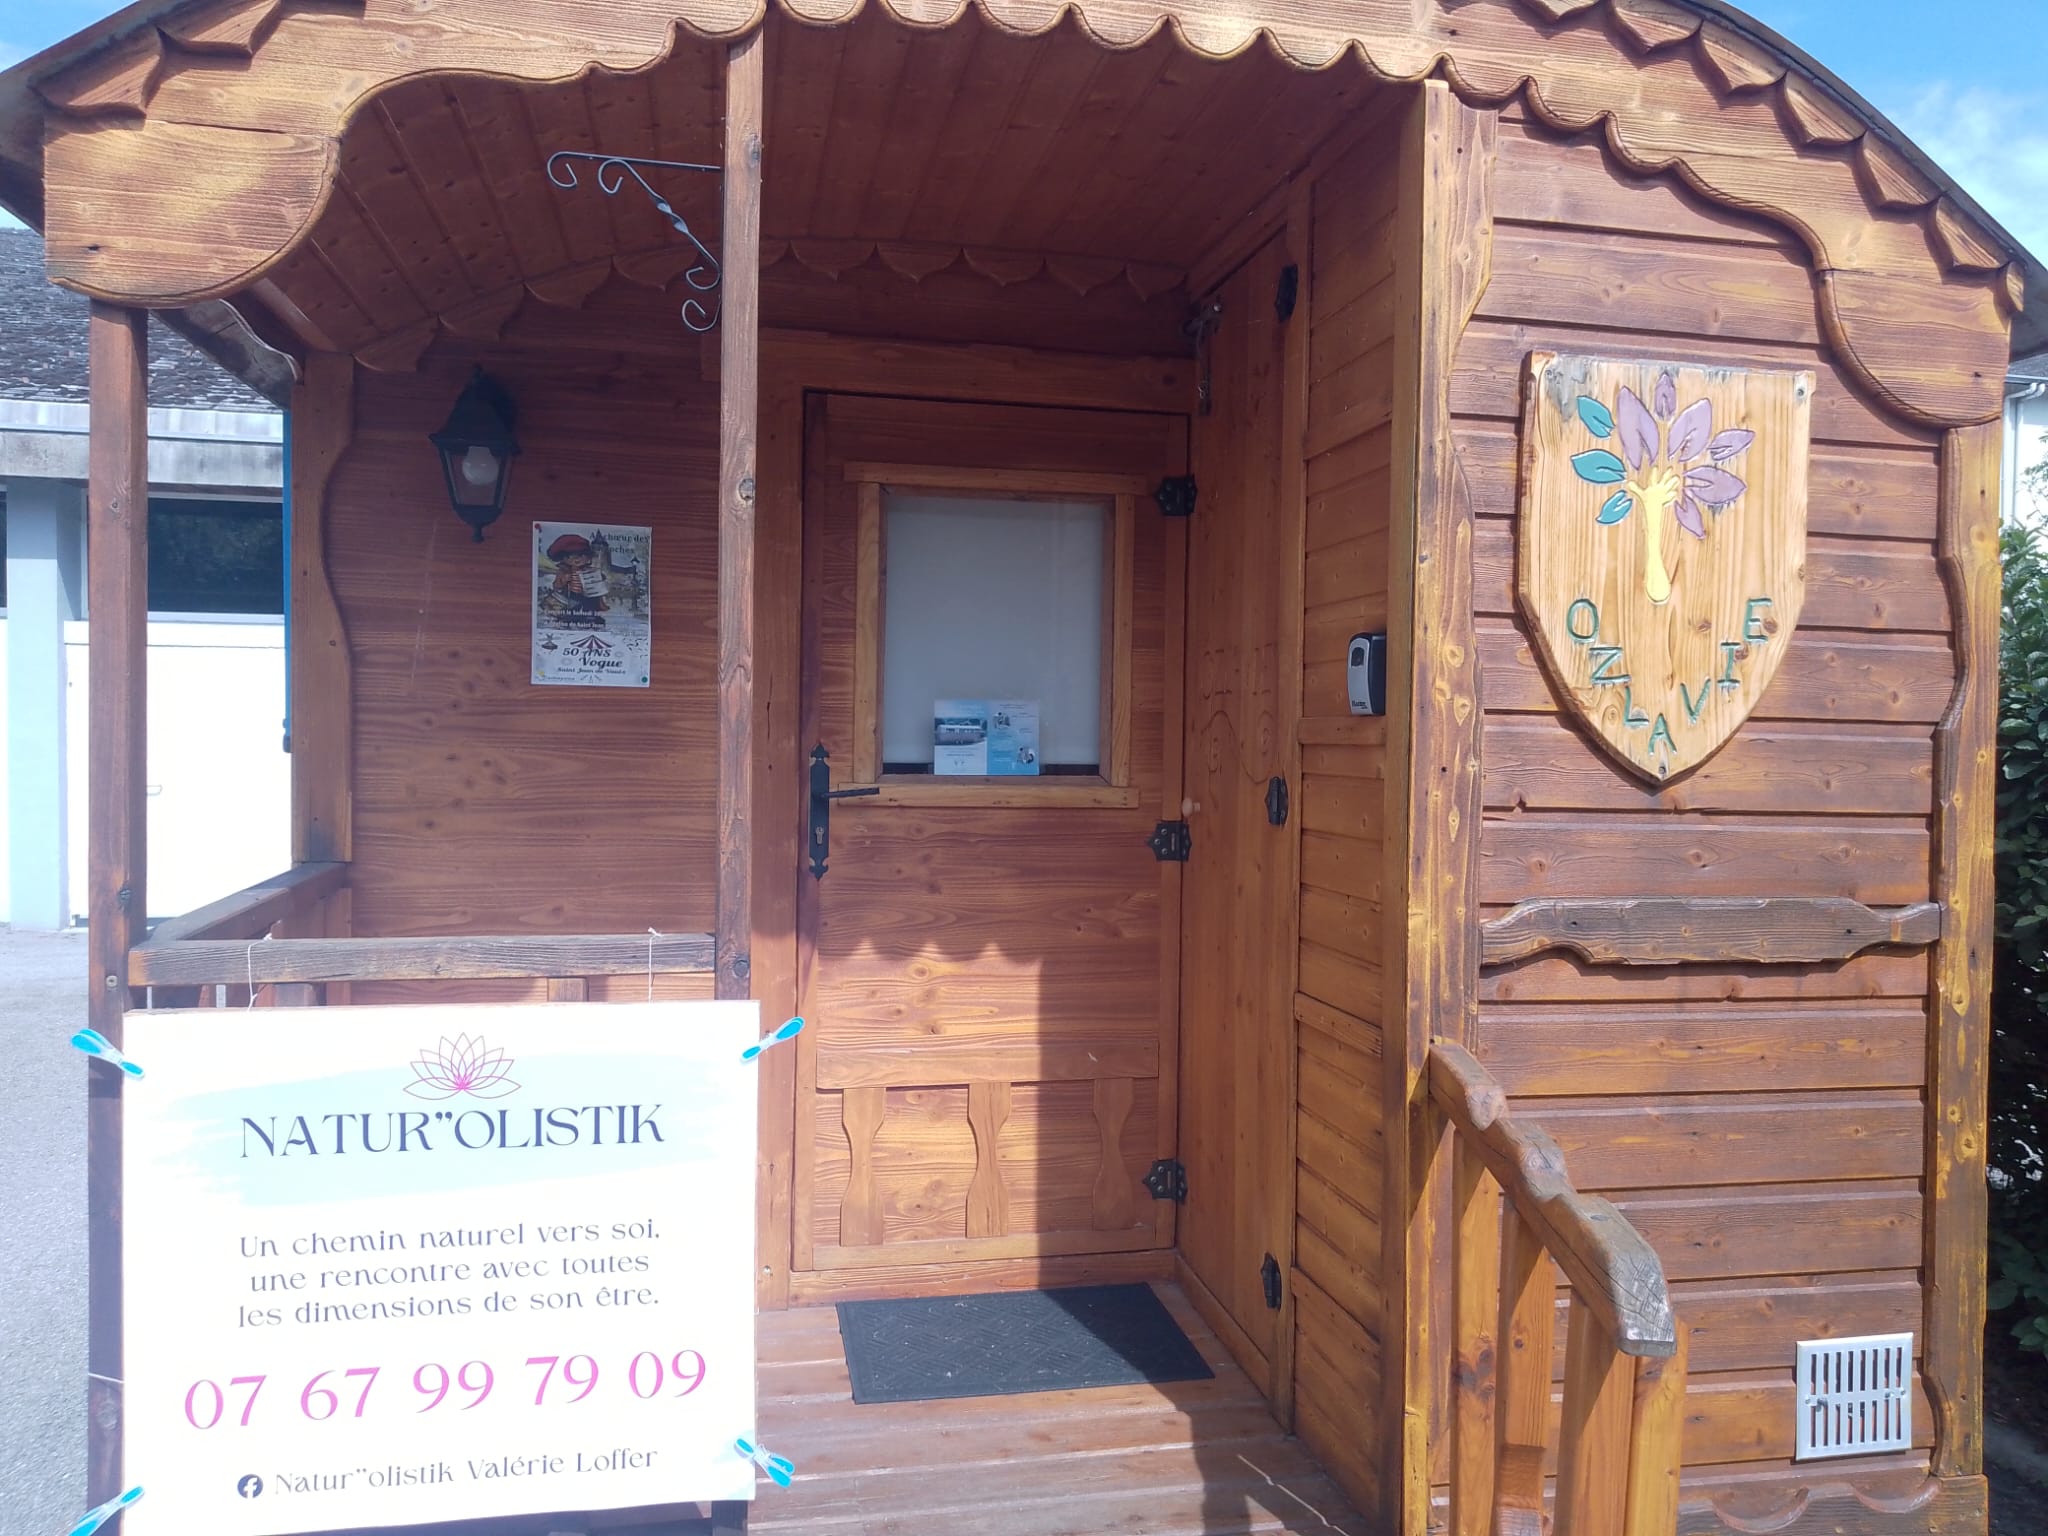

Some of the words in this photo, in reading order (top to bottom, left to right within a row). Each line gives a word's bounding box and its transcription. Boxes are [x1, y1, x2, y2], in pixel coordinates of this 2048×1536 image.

[562, 647, 579, 657] 50
[578, 657, 623, 669] Vogue
[240, 1236, 278, 1258] Un
[292, 1231, 405, 1255] chemin
[420, 1223, 524, 1249] naturel
[537, 1224, 600, 1243] vers
[611, 1218, 661, 1239] soi.
[250, 1273, 306, 1292] une
[320, 1264, 471, 1289] rencontre
[482, 1260, 549, 1279] avec
[562, 1255, 649, 1275] toutes
[239, 1305, 282, 1328] les
[295, 1297, 472, 1324] dimensions
[483, 1291, 517, 1313] de
[530, 1291, 584, 1309] son
[596, 1287, 659, 1307] être.
[184, 1374, 267, 1430] 07
[300, 1367, 381, 1421] 67
[412, 1360, 495, 1413] 99
[525, 1354, 599, 1406] 79
[628, 1349, 707, 1399] 09
[467, 1453, 565, 1480] Valérie
[576, 1448, 658, 1473] Loffer
